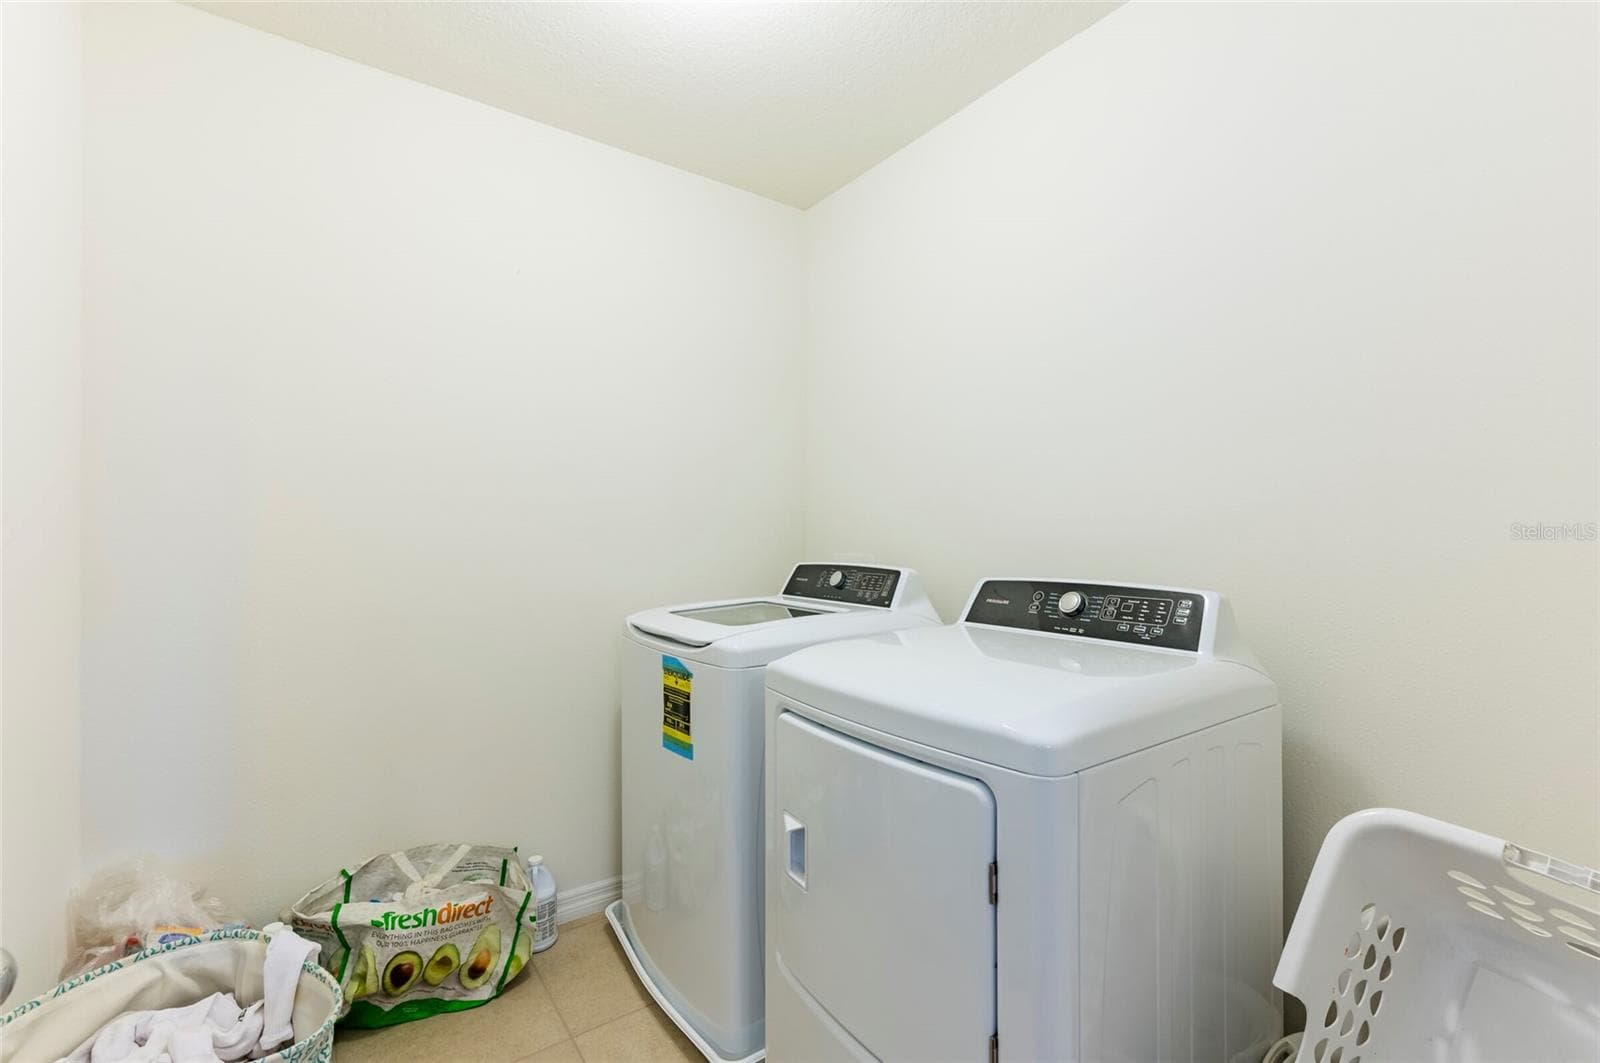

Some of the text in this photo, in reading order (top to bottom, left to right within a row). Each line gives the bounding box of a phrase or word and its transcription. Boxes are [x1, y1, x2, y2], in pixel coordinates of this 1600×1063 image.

[424, 929, 439, 937] THIS
[440, 925, 454, 934] BAG
[454, 919, 476, 930] COMES
[376, 940, 390, 948] OUR
[410, 934, 448, 946] HAPPINESS
